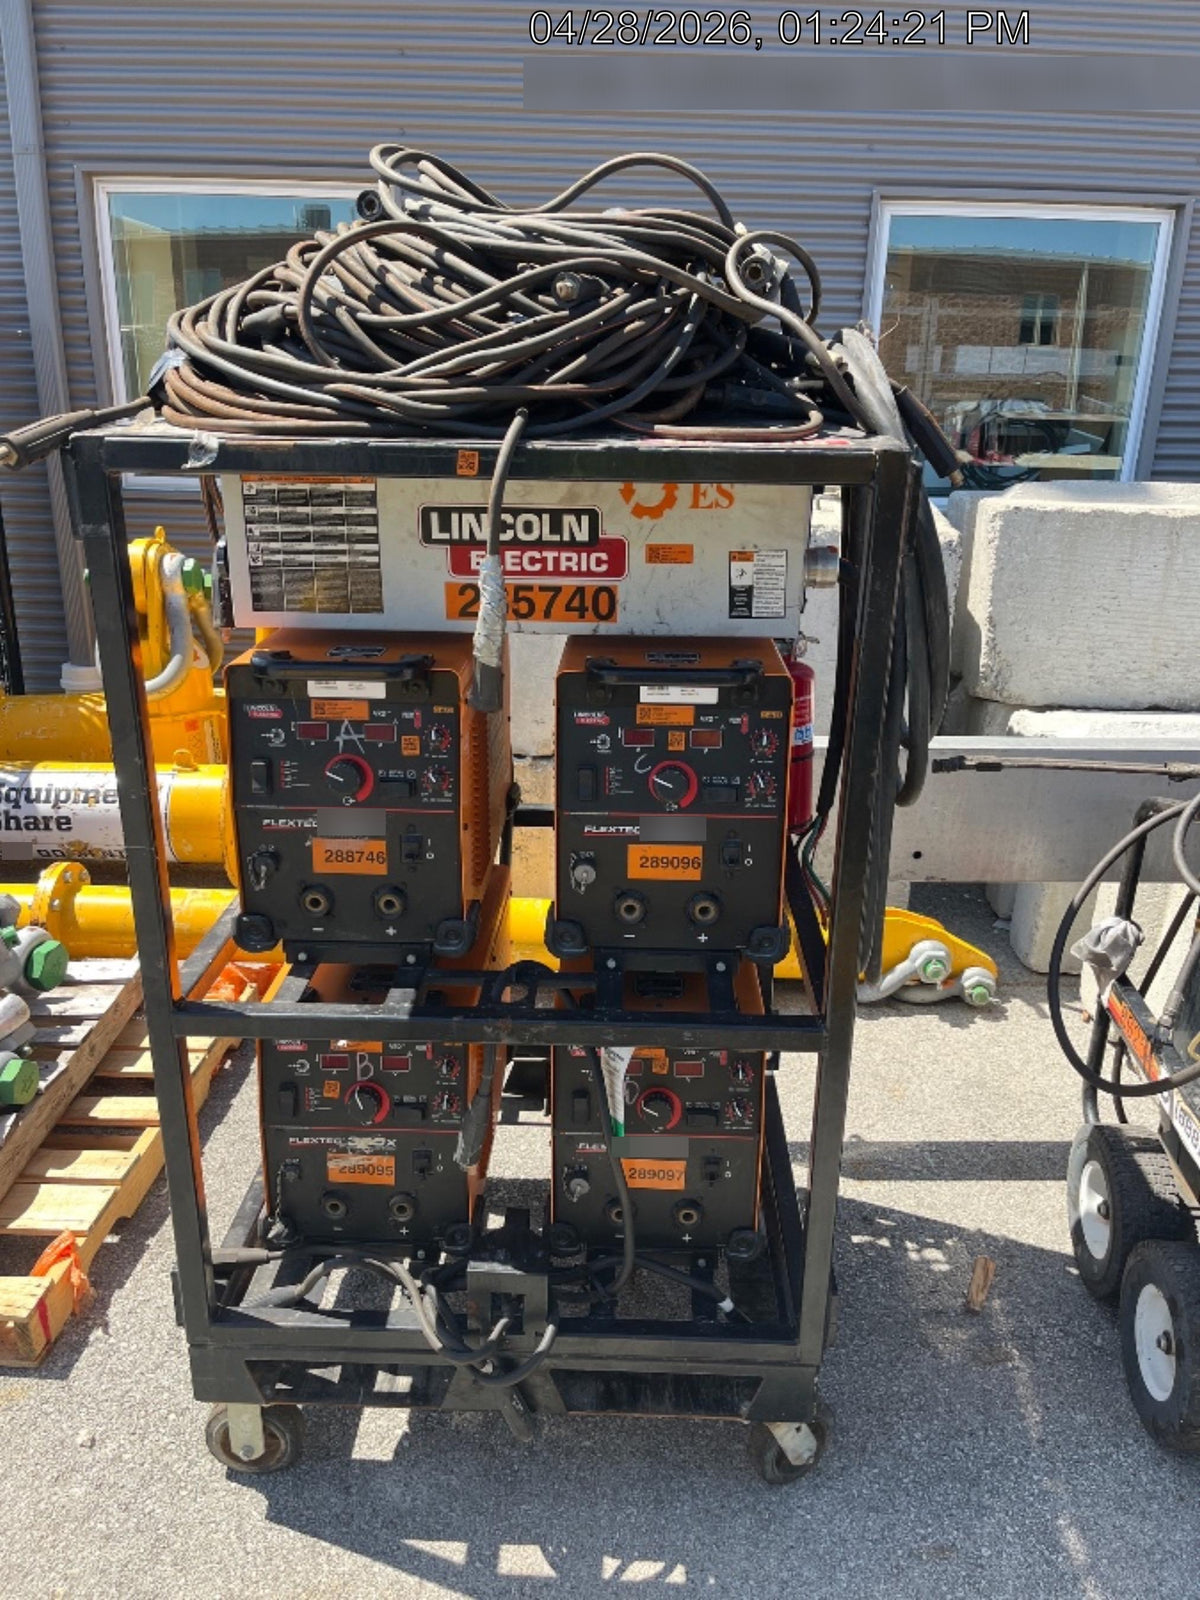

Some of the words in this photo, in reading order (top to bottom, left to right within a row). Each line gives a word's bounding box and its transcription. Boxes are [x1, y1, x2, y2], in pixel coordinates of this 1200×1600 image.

[430, 511, 590, 542] LINCOLN
[470, 551, 609, 573] EECTRIC
[458, 582, 616, 621] 25740
[334, 718, 365, 754] A
[0, 809, 73, 832] hare
[324, 849, 386, 865] 288746
[639, 856, 702, 870] 289096
[356, 1052, 374, 1081] B
[628, 1167, 685, 1181] 289097
